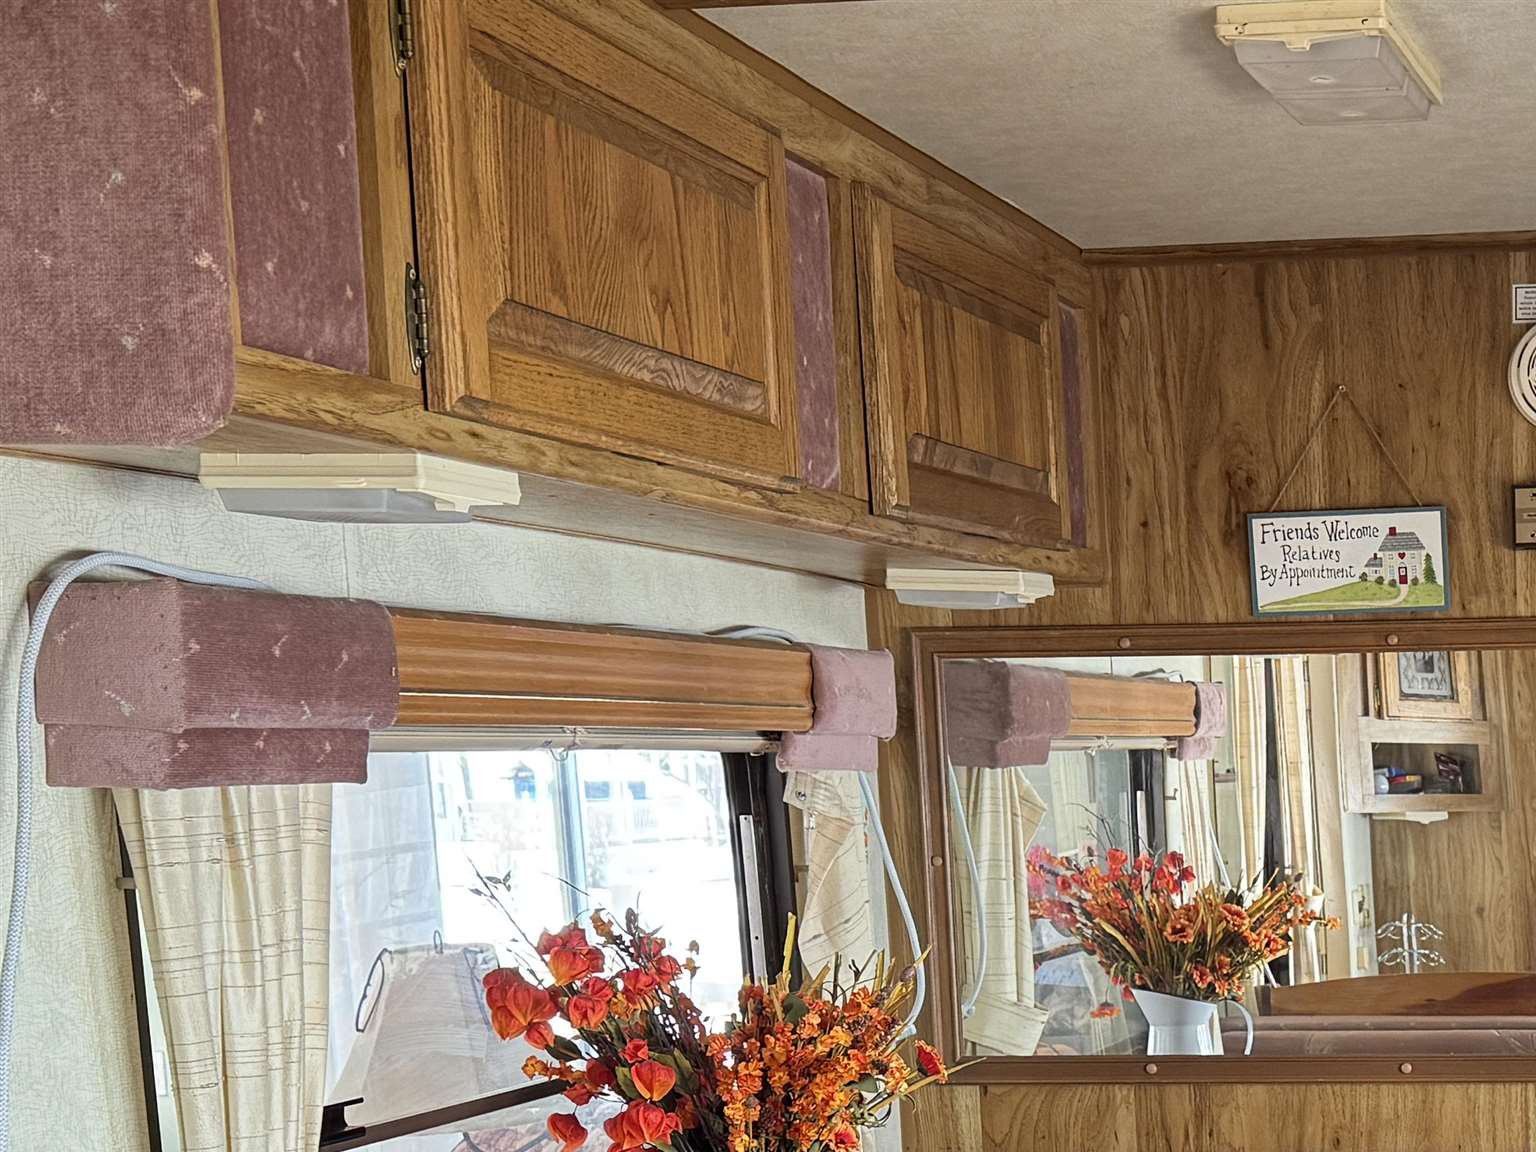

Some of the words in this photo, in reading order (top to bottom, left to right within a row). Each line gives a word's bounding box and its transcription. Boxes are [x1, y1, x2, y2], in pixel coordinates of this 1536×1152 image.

[1260, 522, 1320, 545] Friends
[1321, 520, 1380, 542] Welcome
[1280, 544, 1341, 563] Relatives
[1260, 564, 1277, 587] By
[1278, 563, 1356, 587] Appointment
